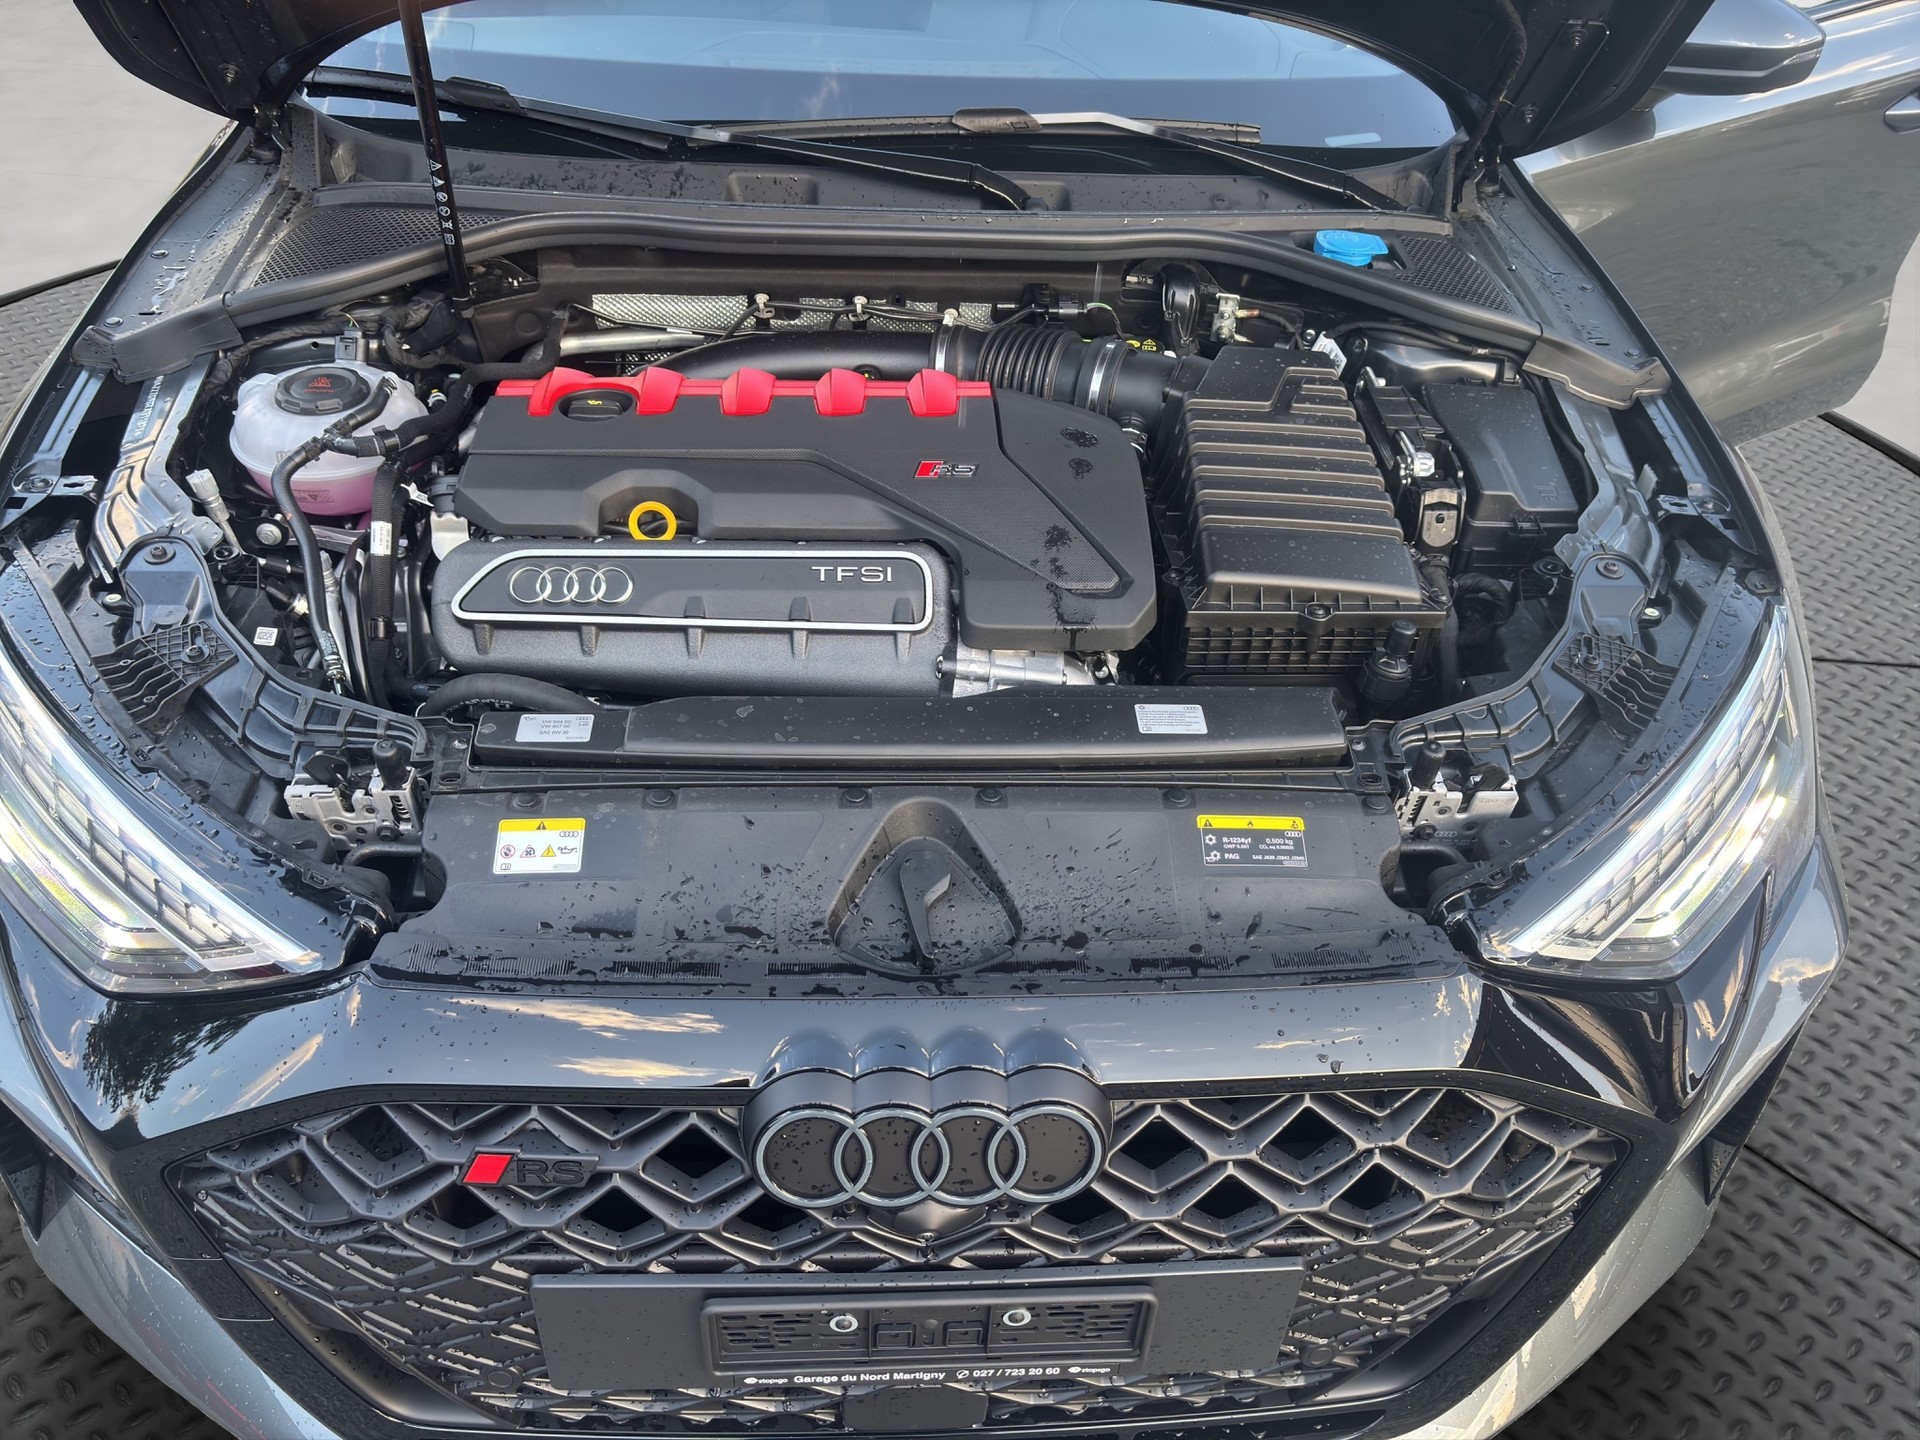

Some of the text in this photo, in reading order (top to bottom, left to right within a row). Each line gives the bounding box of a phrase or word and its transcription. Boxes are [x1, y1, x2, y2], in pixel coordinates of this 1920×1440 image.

[929, 463, 976, 478] RS
[811, 566, 892, 582] TFSI
[1222, 836, 1252, 844] R-1234yf
[516, 1159, 585, 1185] RS
[793, 1375, 839, 1384] Garage
[841, 1373, 857, 1382] du
[860, 1372, 890, 1381] Nord
[892, 1371, 946, 1382] Martigny
[972, 1369, 995, 1378] 027
[1004, 1368, 1026, 1377] 723
[1028, 1368, 1043, 1376] 20
[1045, 1367, 1060, 1375] 60
